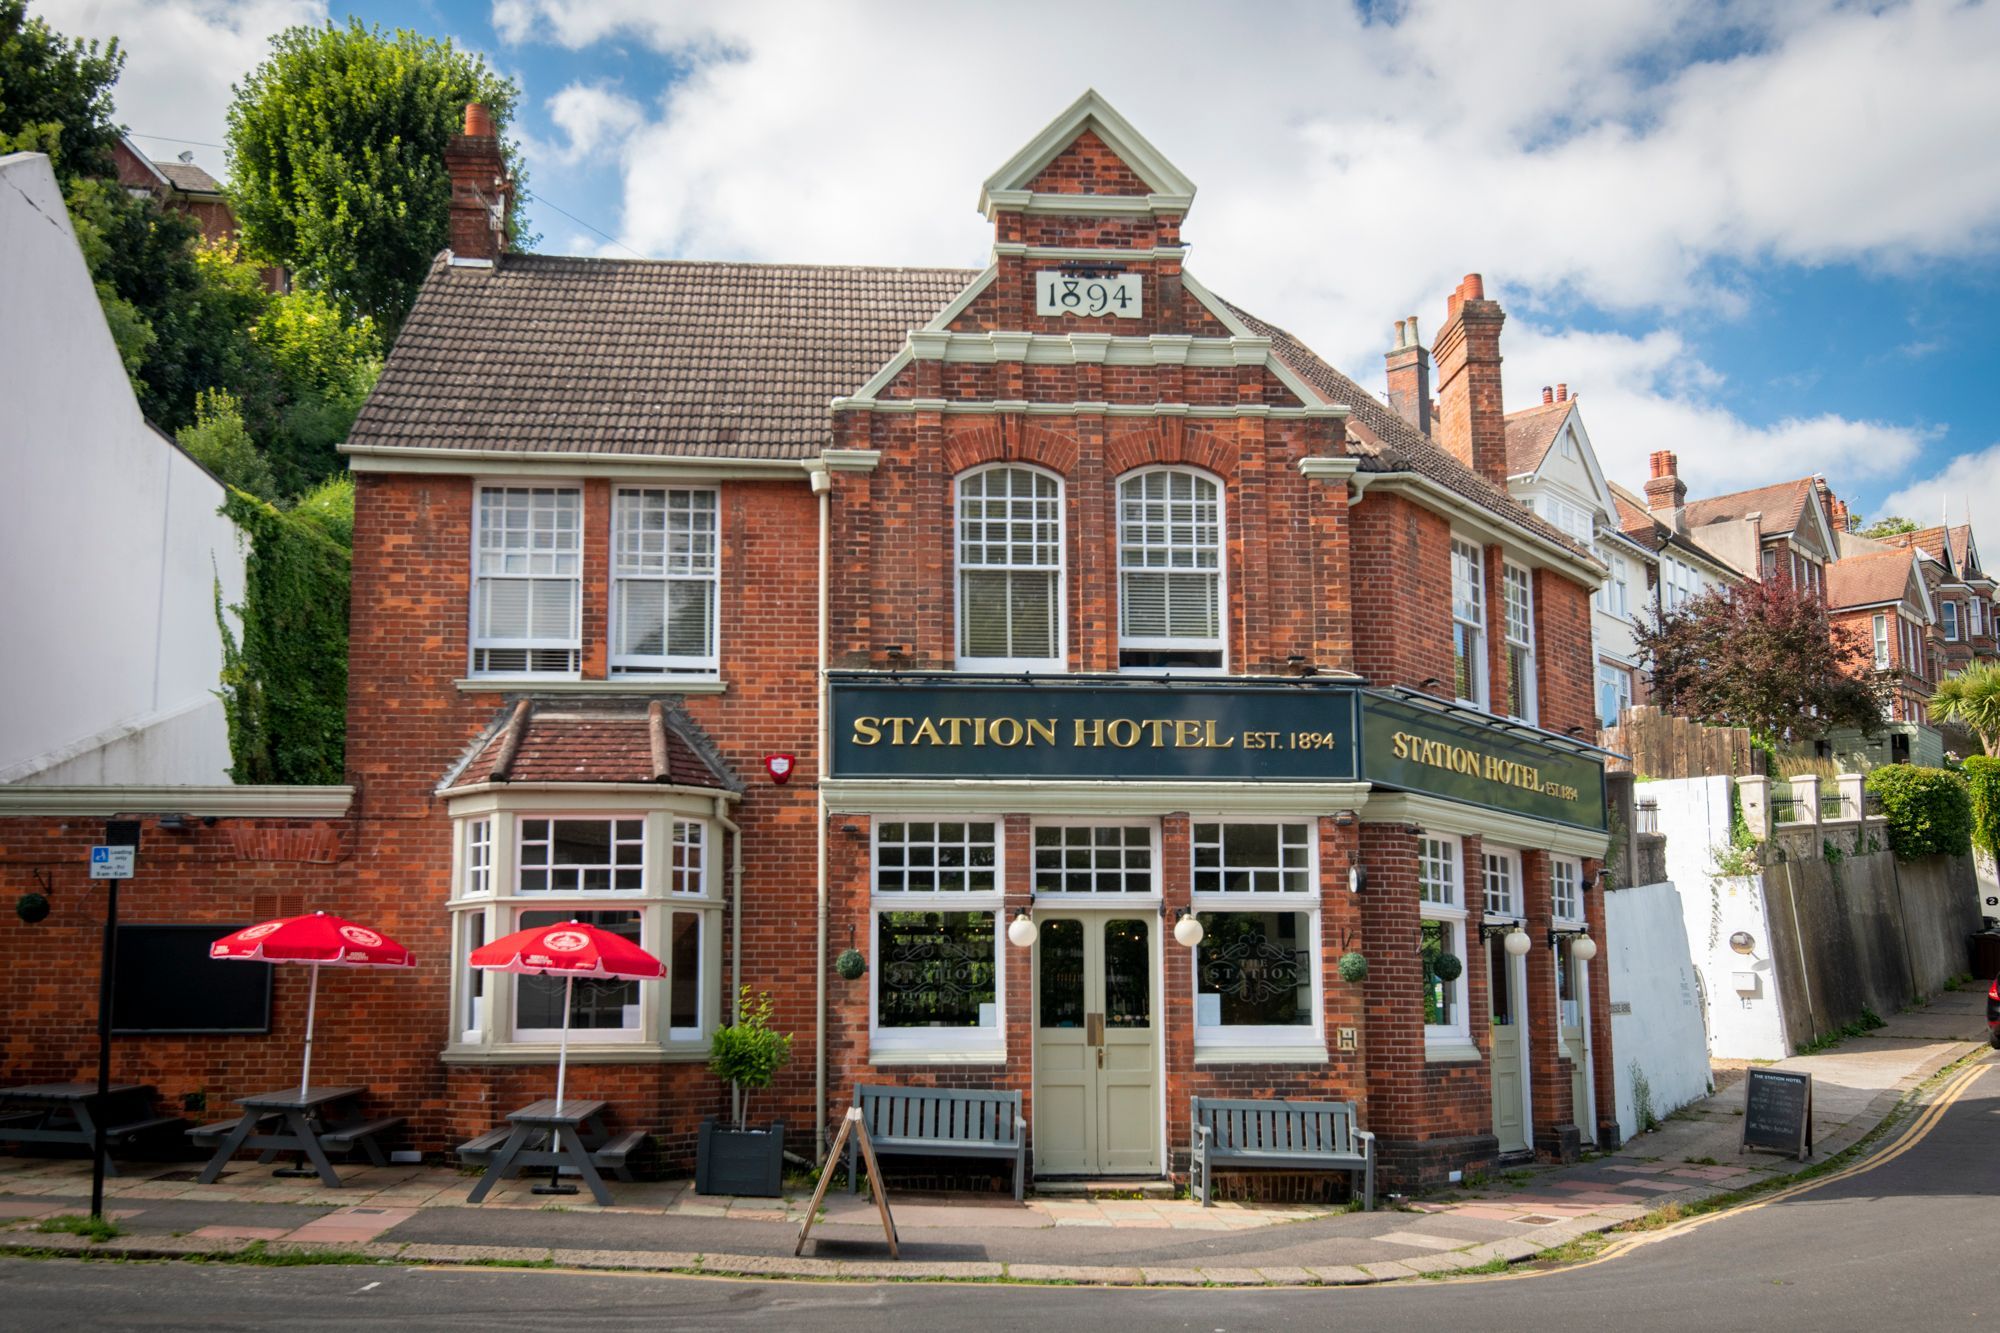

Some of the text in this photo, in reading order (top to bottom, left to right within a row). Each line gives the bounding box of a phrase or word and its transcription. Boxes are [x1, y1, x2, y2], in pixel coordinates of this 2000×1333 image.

[1049, 281, 1133, 312] 1894
[852, 716, 1335, 750] STATION HOTEL EST. 1894
[1392, 731, 1578, 801] STATION HOTEL EST. 1894
[1210, 968, 1298, 980] STATION
[1239, 959, 1268, 968] THE
